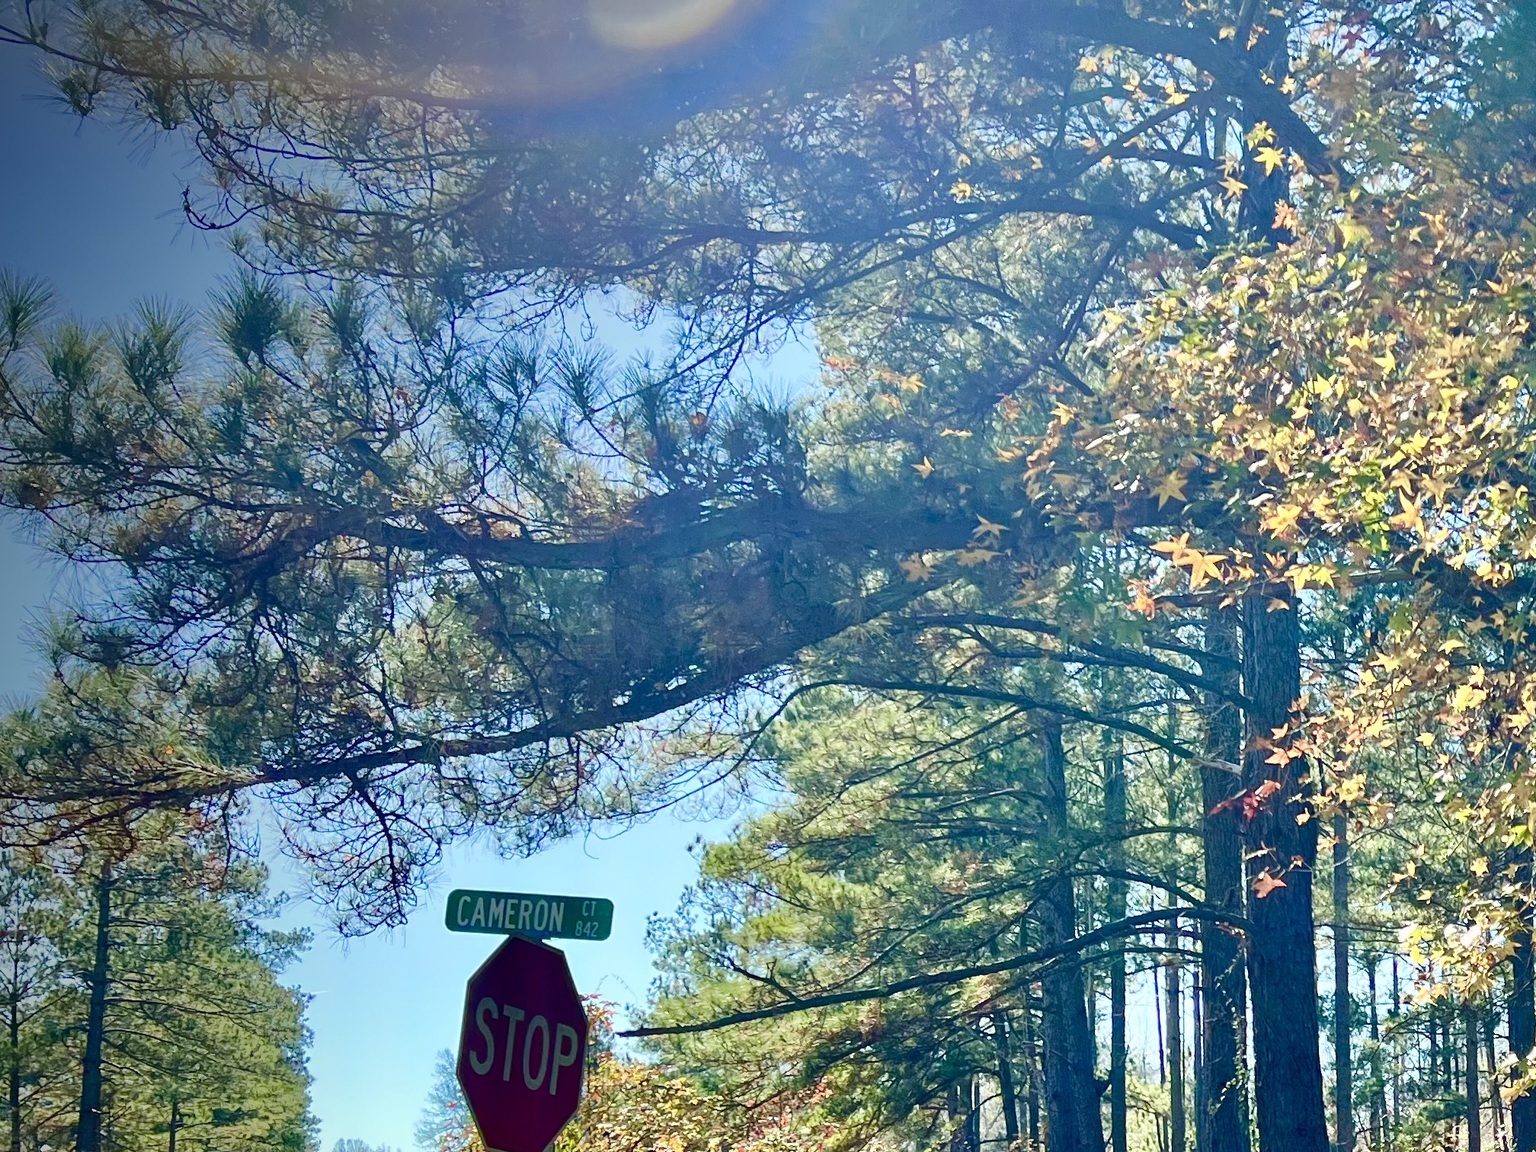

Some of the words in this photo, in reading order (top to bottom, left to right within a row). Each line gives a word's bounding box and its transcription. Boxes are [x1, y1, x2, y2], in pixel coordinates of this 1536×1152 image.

[457, 896, 564, 932] CAMERON
[582, 900, 597, 917] CT
[574, 920, 599, 938] 842
[469, 997, 578, 1095] STOP
